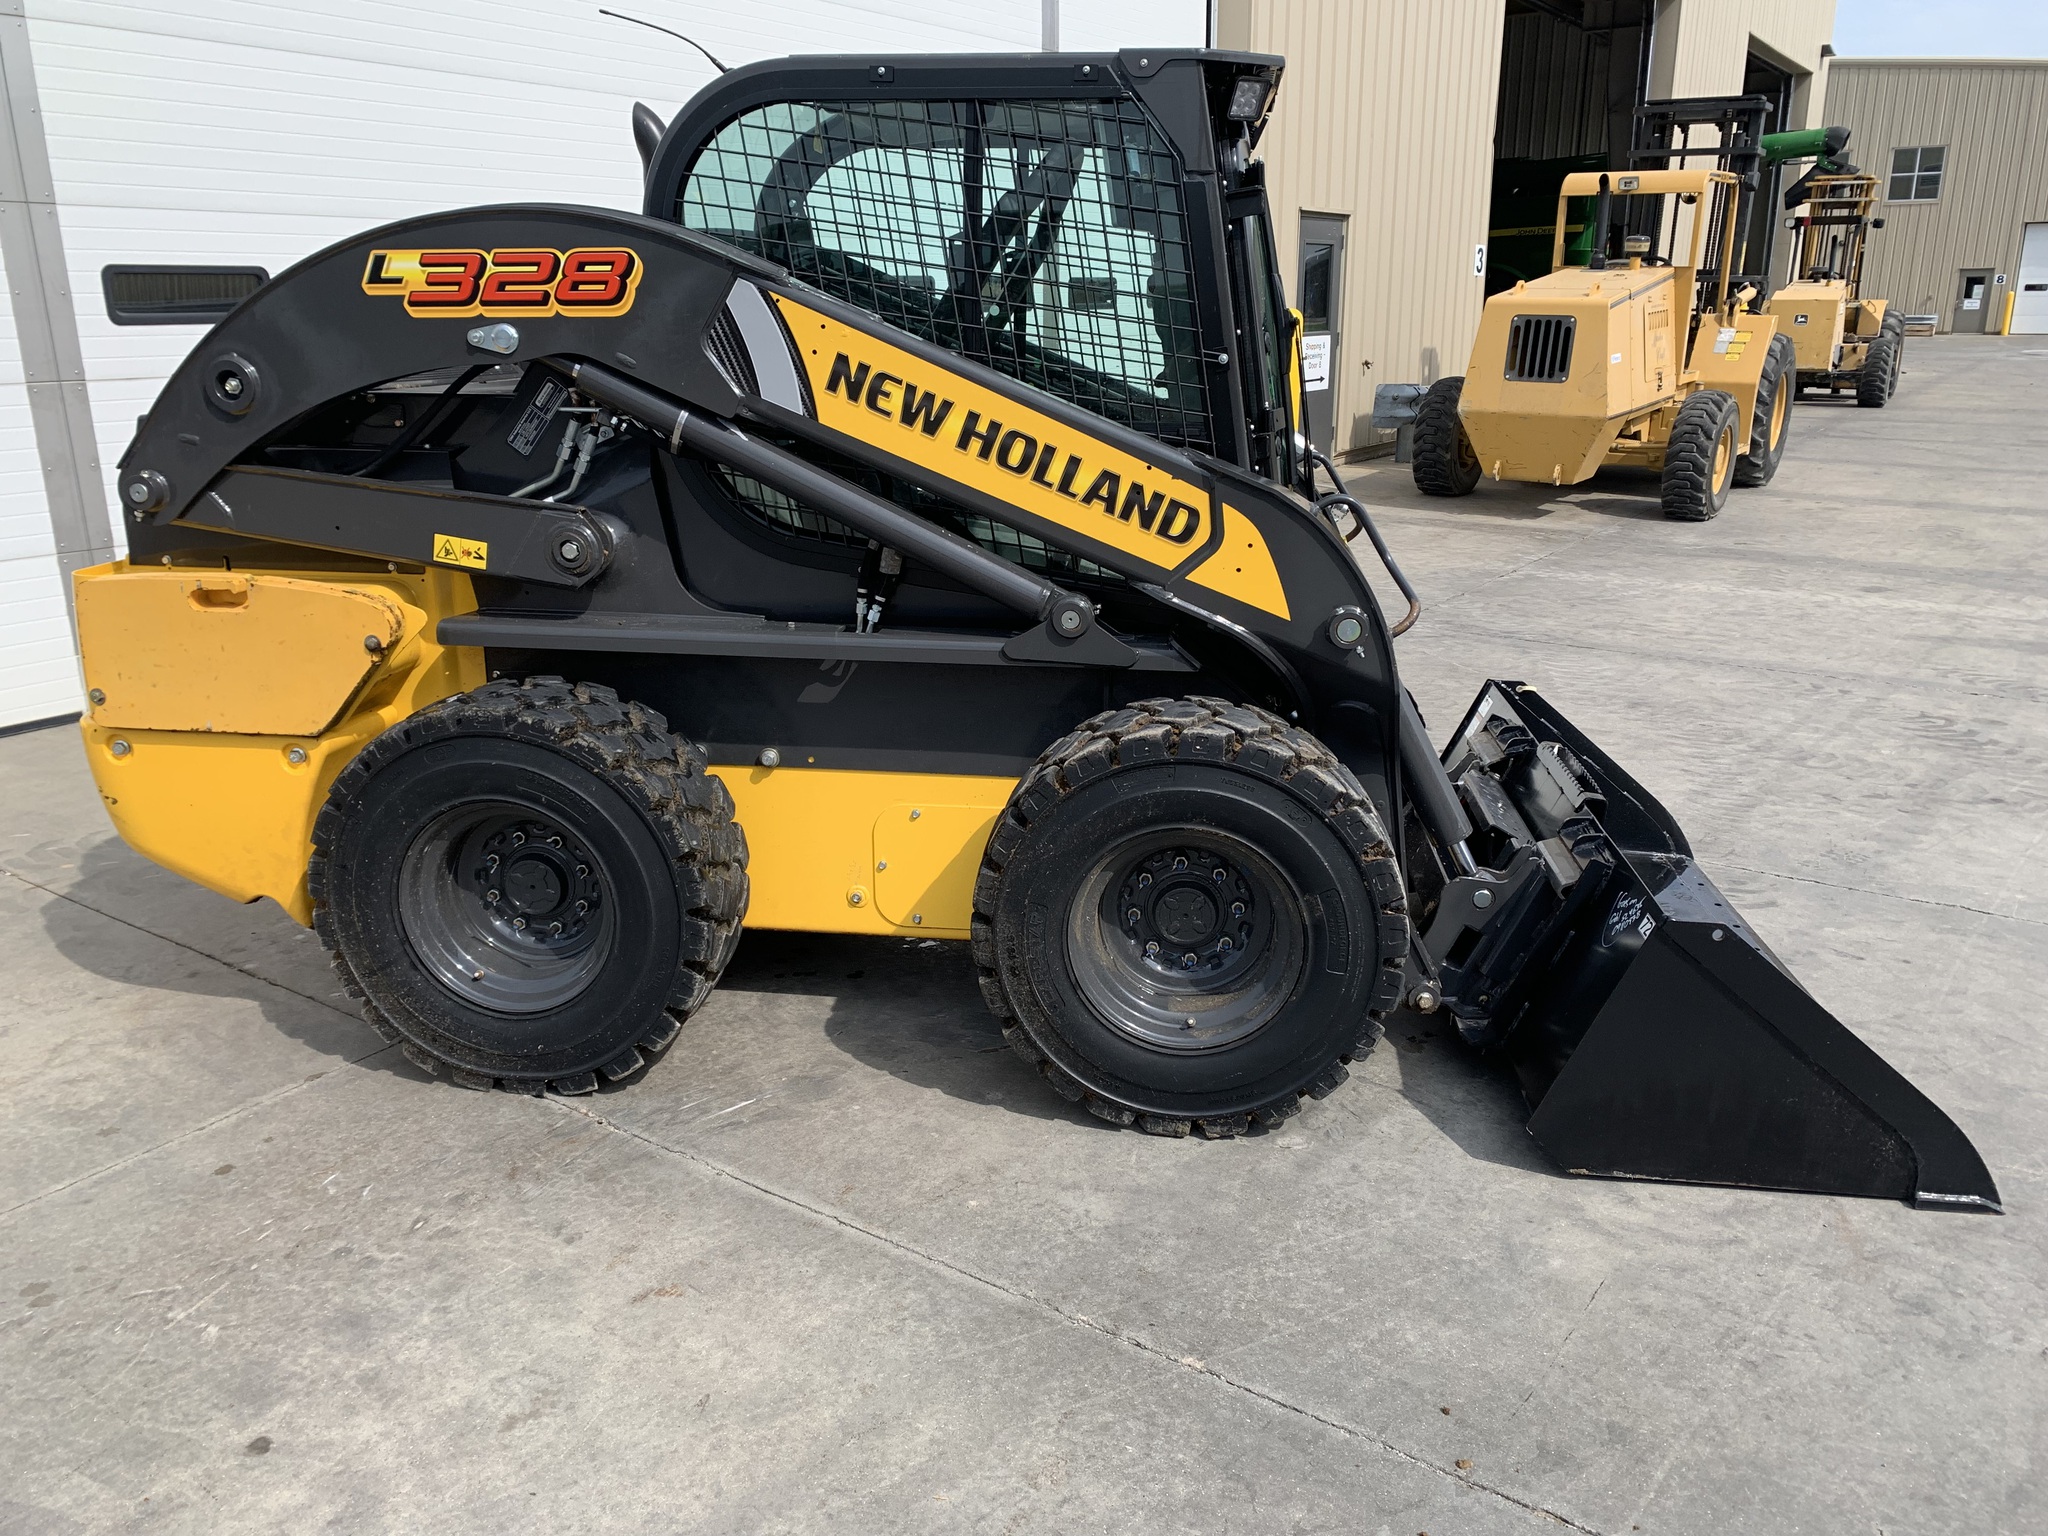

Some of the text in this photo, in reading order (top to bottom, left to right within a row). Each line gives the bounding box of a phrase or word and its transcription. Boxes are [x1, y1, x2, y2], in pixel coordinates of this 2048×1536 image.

[1516, 226, 1556, 236] JOHN DEER
[1476, 247, 1484, 274] 3
[362, 249, 642, 315] L328
[1996, 274, 2004, 283] 8
[825, 351, 1201, 545] NEW HOLLAND
[1640, 915, 1654, 937] 72
